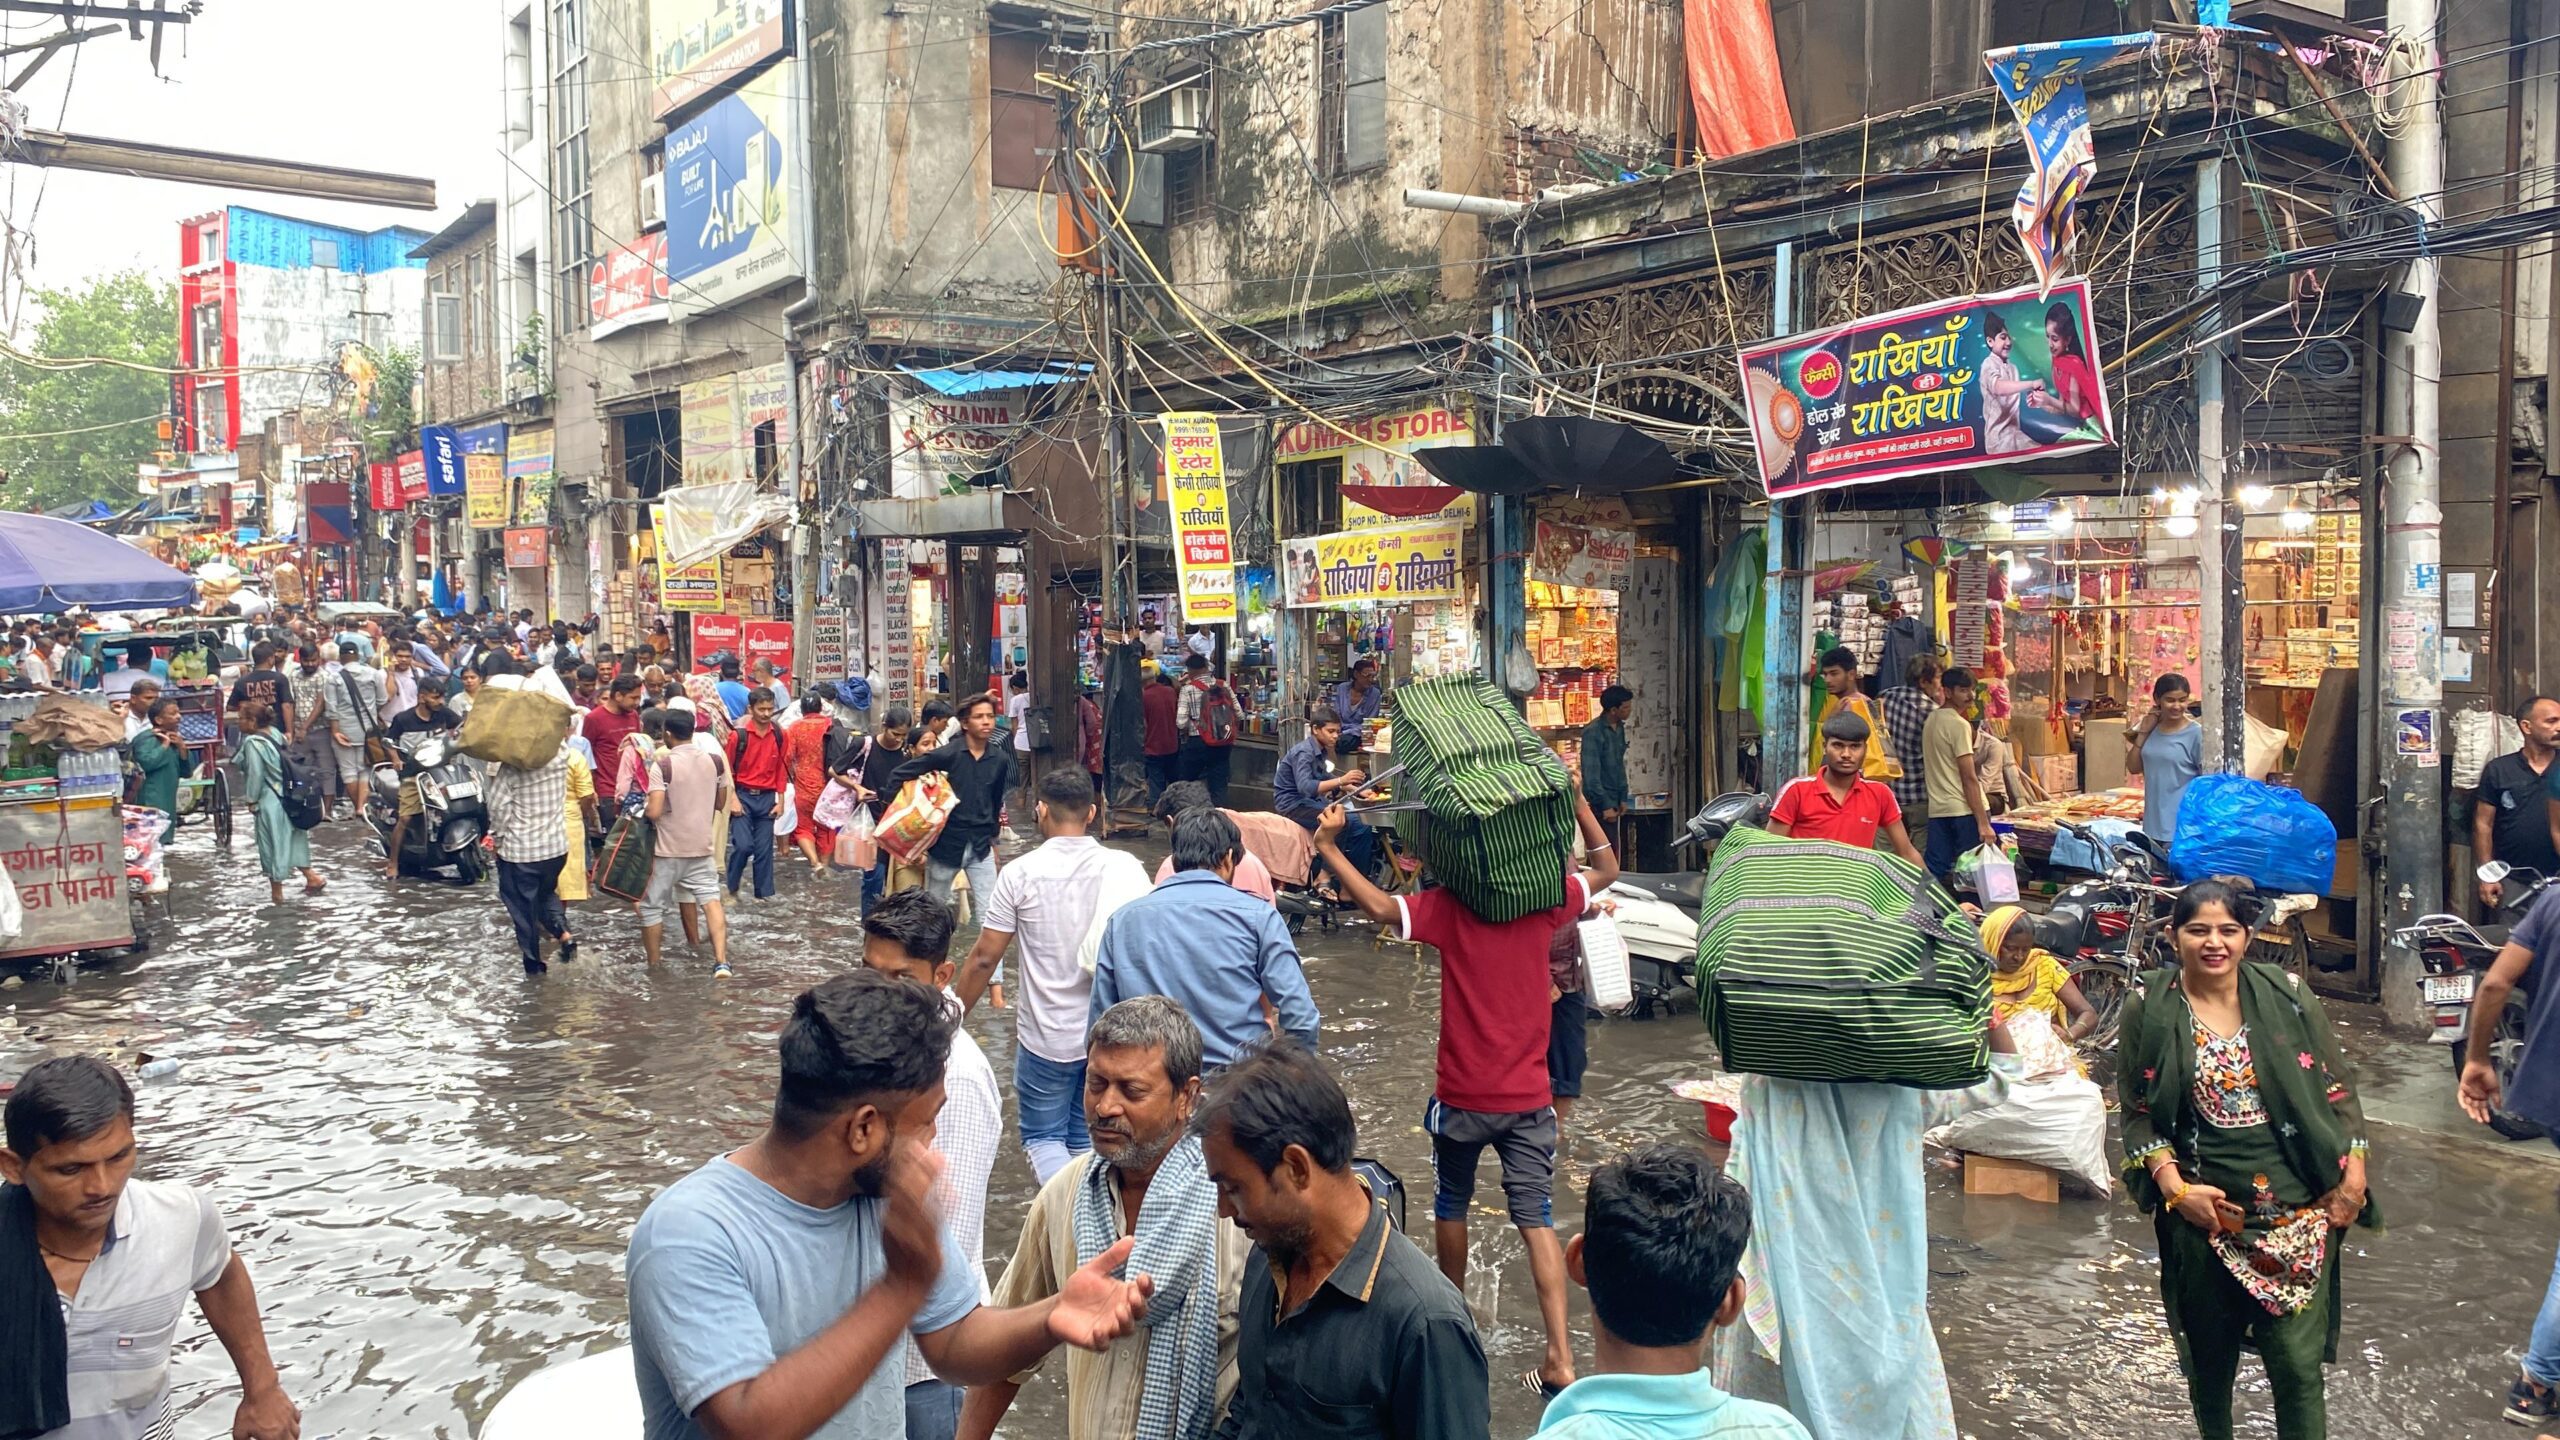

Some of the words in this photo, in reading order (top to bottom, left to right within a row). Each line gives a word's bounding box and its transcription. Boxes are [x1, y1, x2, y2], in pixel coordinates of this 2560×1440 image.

[676, 126, 707, 159] BAJAJ
[681, 161, 701, 186] BUILT
[1850, 315, 1971, 384] राखियाँ
[1919, 374, 1936, 390] ही
[1852, 369, 1973, 436] राखियाँ
[926, 406, 1010, 425] KHANNA
[1807, 407, 1829, 426] होल
[1278, 418, 1373, 457] KUMAR
[1376, 408, 1468, 443] STORE
[1170, 436, 1214, 454] कुमार
[435, 436, 456, 484] safari
[1179, 453, 1213, 468] स्टोर
[1196, 472, 1221, 490] राखियाँ
[1180, 507, 1224, 525] राखियाँ
[1349, 517, 1365, 527] SHOP
[1367, 515, 1379, 525] NO.
[1444, 506, 1471, 518] DELHI-6
[1184, 532, 1206, 546] होल
[1207, 531, 1226, 545] सेल
[1324, 554, 1377, 596] राखियाँ
[1378, 565, 1391, 586] ही
[1395, 548, 1456, 592] राखियाँ
[815, 617, 841, 626] HAVELLS
[888, 619, 907, 629] BLACK+
[815, 635, 841, 644] DACKER
[816, 654, 842, 663] USHA
[817, 645, 841, 654] VEGA
[889, 669, 908, 679] UNITED
[246, 679, 277, 697] CASE
[889, 681, 907, 690] USHA
[70, 842, 108, 865] का
[56, 868, 118, 905] पानी
